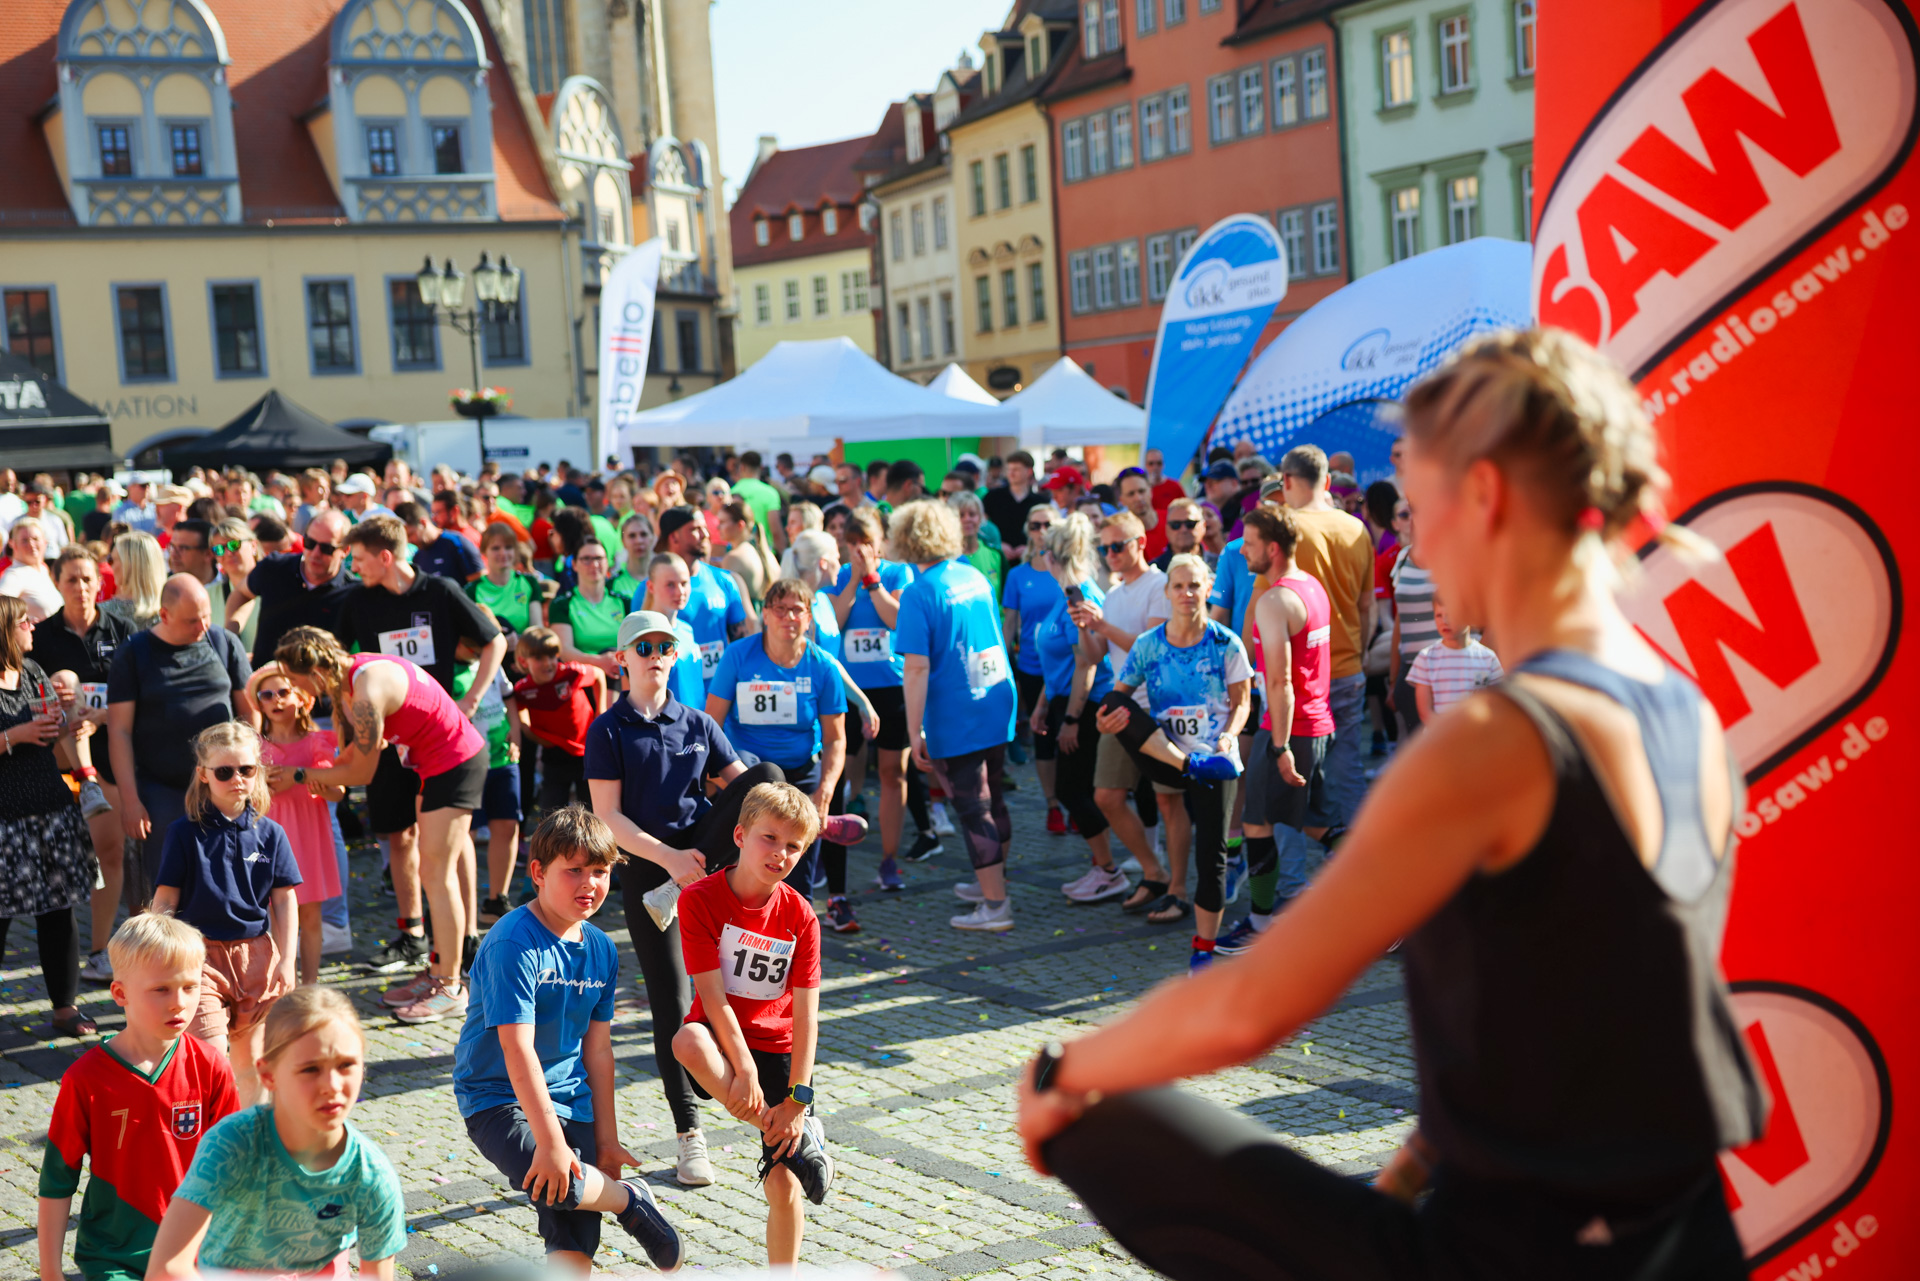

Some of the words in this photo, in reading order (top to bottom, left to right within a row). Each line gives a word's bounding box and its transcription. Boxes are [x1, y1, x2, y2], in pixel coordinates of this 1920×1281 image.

[1642, 203, 1910, 422] w.radiosaw.de
[0, 380, 47, 410] TA
[91, 393, 199, 420] MATION
[395, 639, 418, 657] 10
[853, 637, 882, 653] 134
[754, 693, 777, 713] 81
[1165, 718, 1199, 736] 103
[738, 932, 793, 955] FIRMENLAUF
[733, 948, 788, 984] 153
[171, 1099, 201, 1108] PORTUGAL
[110, 1108, 129, 1150] 7
